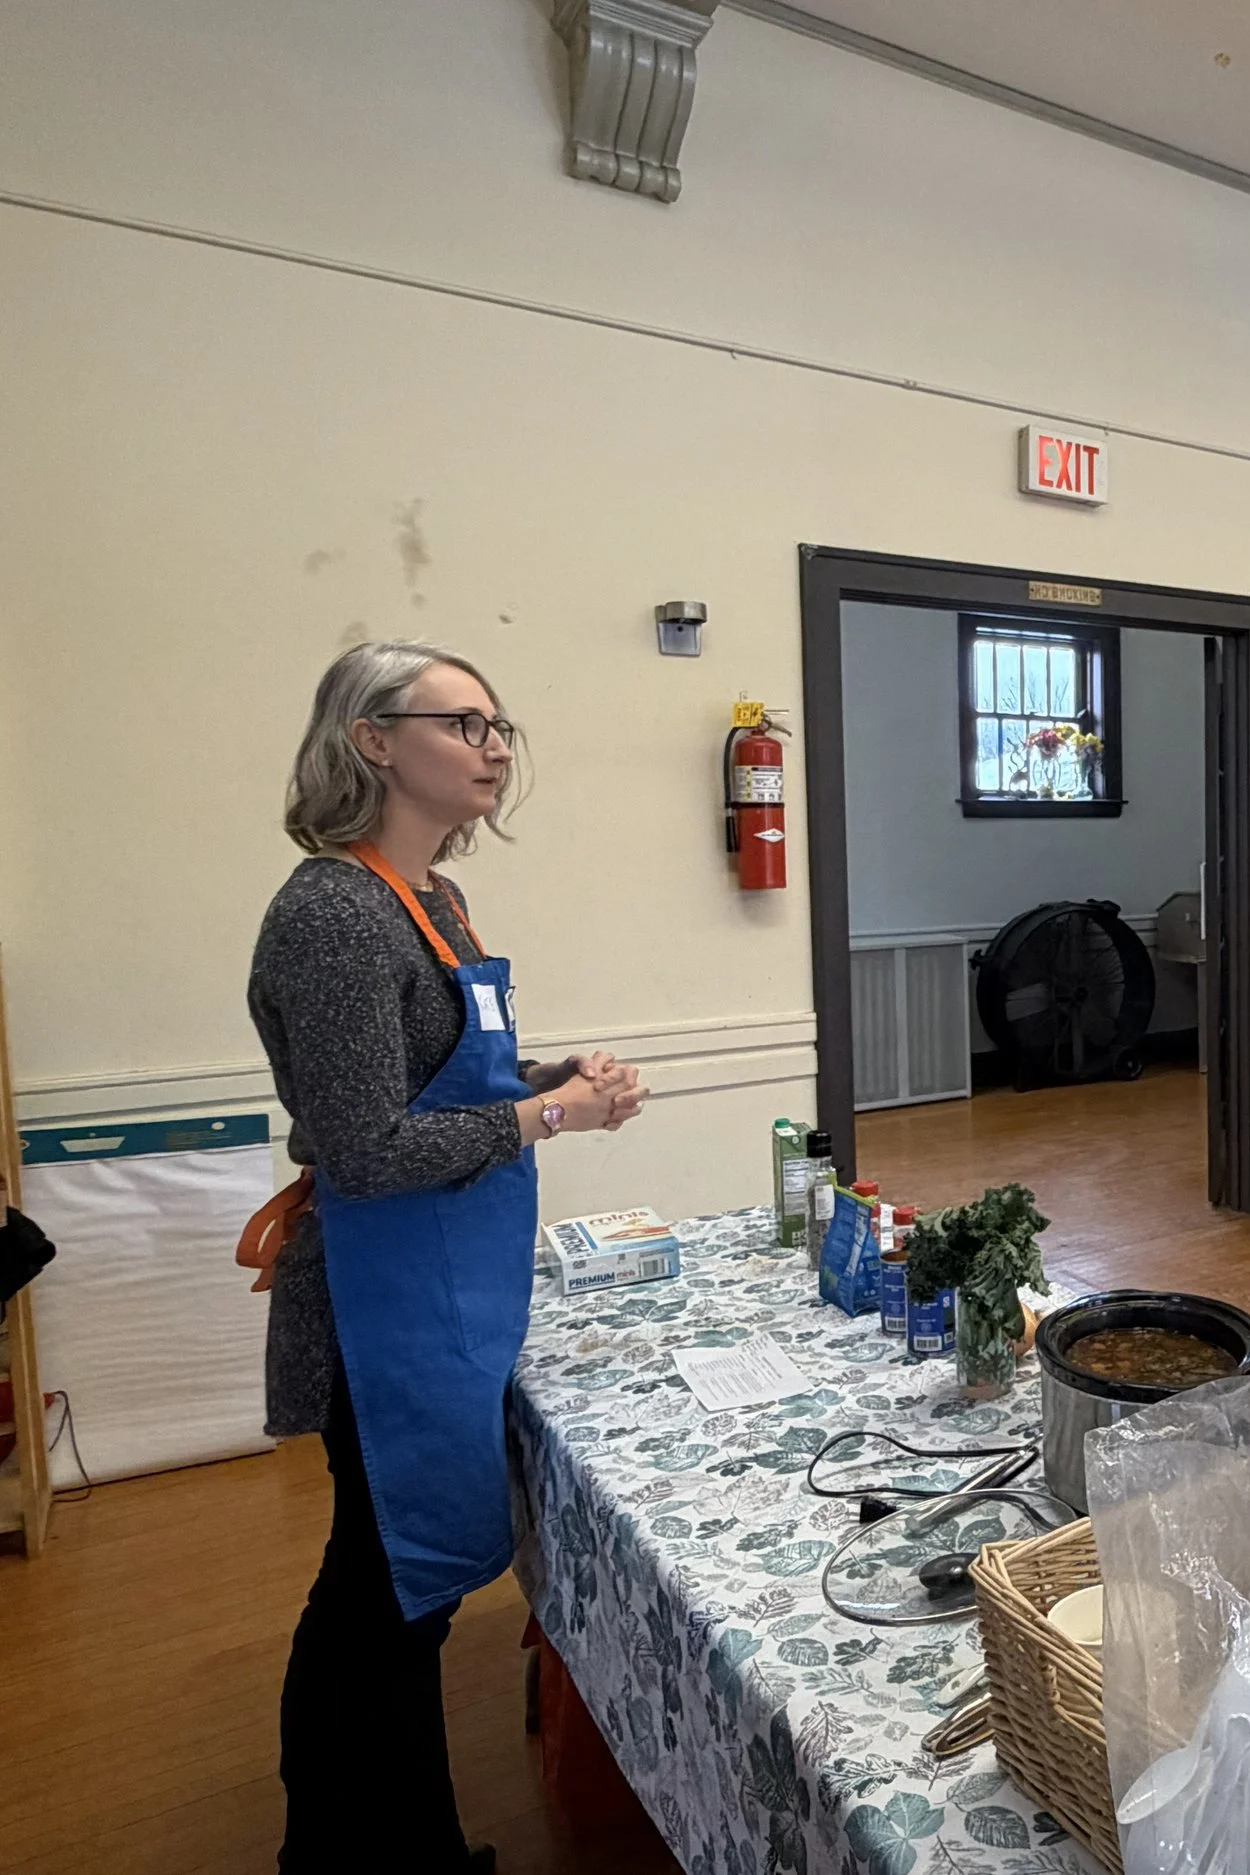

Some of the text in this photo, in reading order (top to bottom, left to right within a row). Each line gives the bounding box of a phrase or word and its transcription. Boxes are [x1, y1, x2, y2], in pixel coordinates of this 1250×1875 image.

[1038, 435, 1100, 495] EXIT
[589, 1211, 650, 1227] minis
[568, 1272, 615, 1288] PREMIUM
